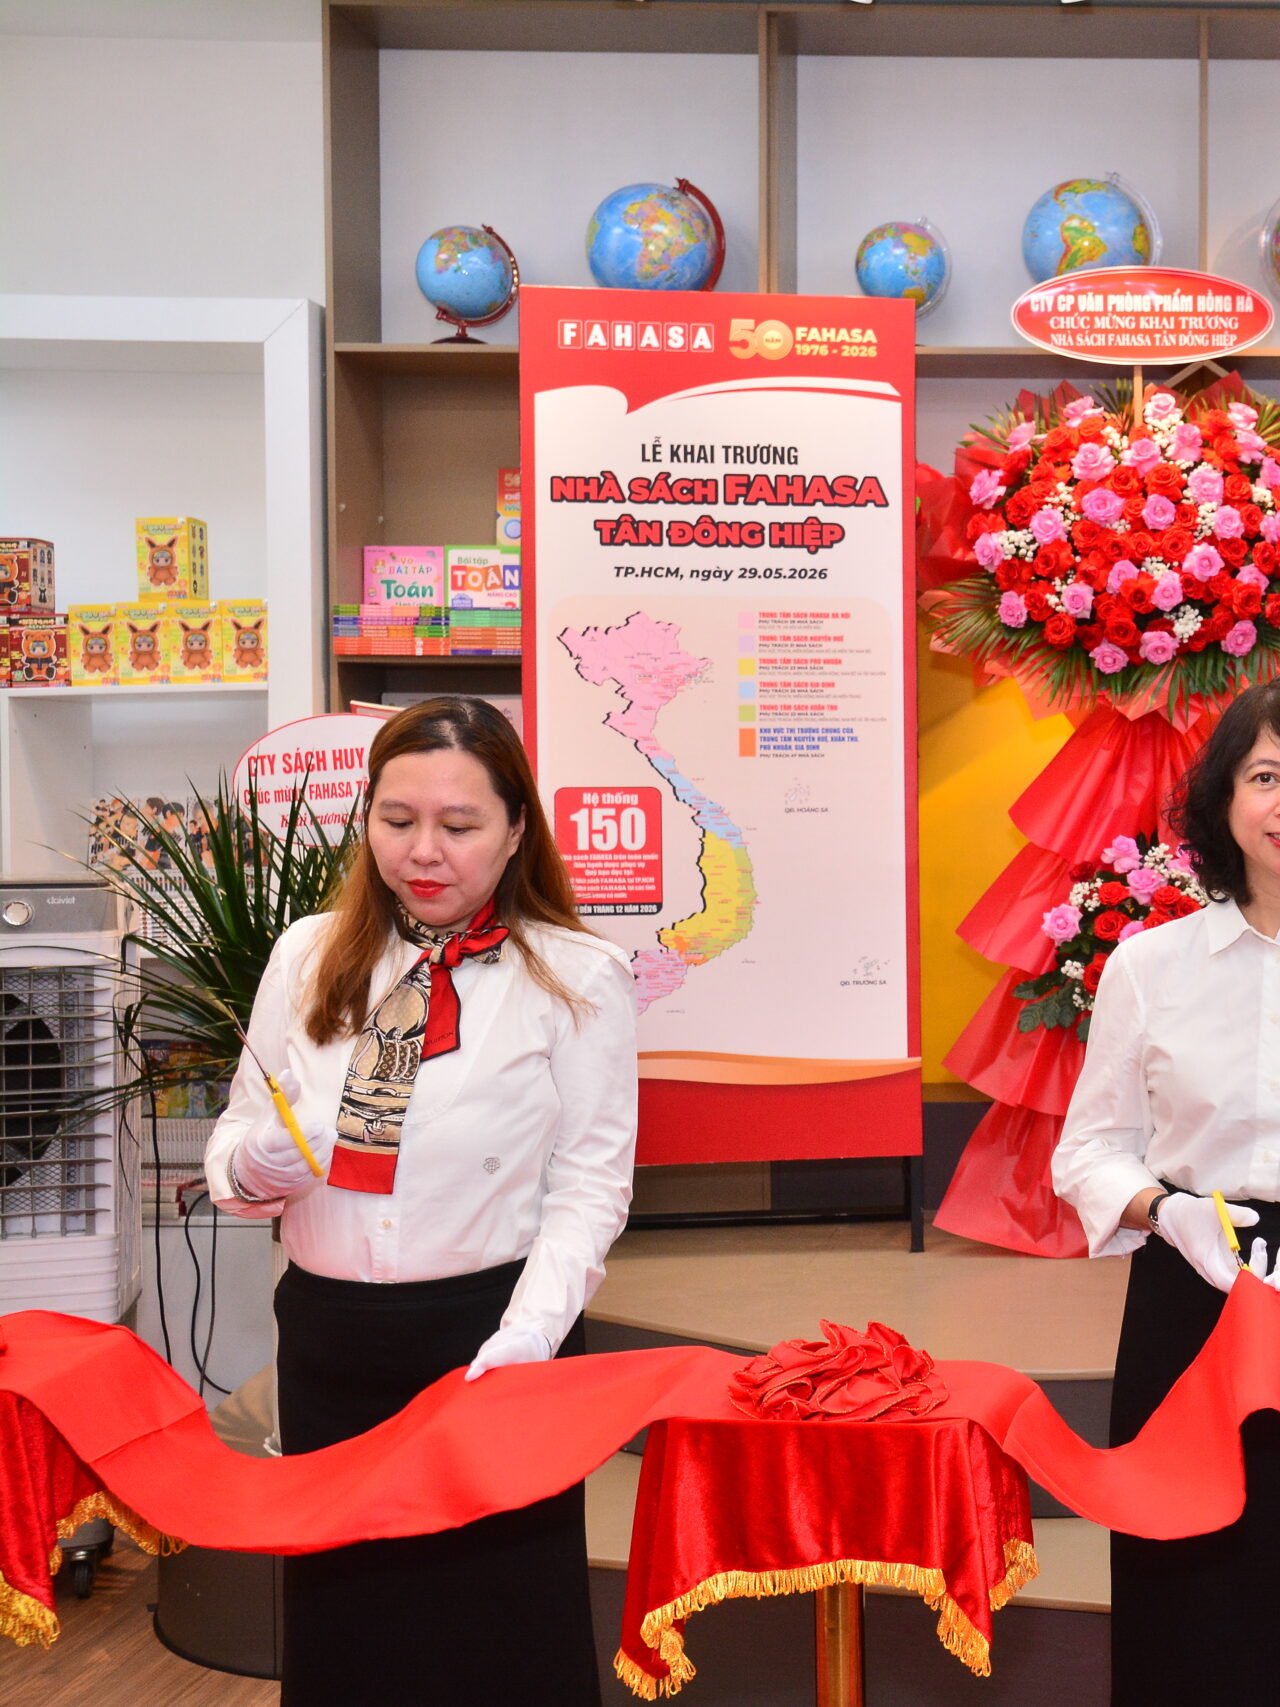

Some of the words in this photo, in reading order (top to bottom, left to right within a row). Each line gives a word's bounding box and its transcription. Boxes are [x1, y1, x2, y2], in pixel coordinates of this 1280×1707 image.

[1030, 295, 1055, 312] CTY
[1057, 294, 1075, 312] CP
[1077, 293, 1105, 312] VĂN
[1108, 291, 1151, 312] PHÒNG
[1154, 289, 1193, 313] PHẨM
[1197, 289, 1231, 312] HỒNG
[1050, 314, 1090, 330] CHÚC
[1094, 314, 1136, 330] MỪNG
[1139, 316, 1175, 330] KHAI
[1178, 315, 1239, 330] TRƯƠNG
[561, 322, 713, 351] FAHASA
[729, 318, 794, 360] 50
[796, 327, 878, 345] FAHASA
[1050, 332, 1075, 347] NHÀ
[1076, 331, 1106, 347] SÁCH
[1108, 333, 1151, 347] FAHASA
[1153, 331, 1176, 347] TÂN
[1178, 331, 1209, 347] ĐÔNG
[1211, 331, 1237, 349] HIỆP
[796, 345, 828, 357] 1976
[841, 345, 878, 357] 2026
[641, 436, 663, 463] LỄ
[670, 444, 715, 464] KHAI
[722, 444, 799, 466] TRƯƠNG
[551, 471, 626, 503] NHÀ
[628, 472, 719, 505] SÁCH
[723, 474, 888, 508] FAHASA
[594, 513, 663, 546] TÂN
[666, 514, 765, 548] ĐÔNG
[769, 516, 845, 554] HIỆP
[453, 568, 519, 587] TOÁN
[614, 566, 685, 581] TP.HCM,
[690, 567, 733, 582] ngày
[738, 567, 828, 580] 29.05.2026
[380, 579, 434, 599] Toán
[247, 754, 276, 777] CTY
[282, 748, 327, 774] SÁCH
[332, 747, 365, 771] HUY
[243, 787, 271, 806] Cúc
[309, 781, 353, 801] FAHASA
[582, 792, 599, 807] Hệ
[601, 791, 639, 805] thống
[570, 807, 646, 851] 150
